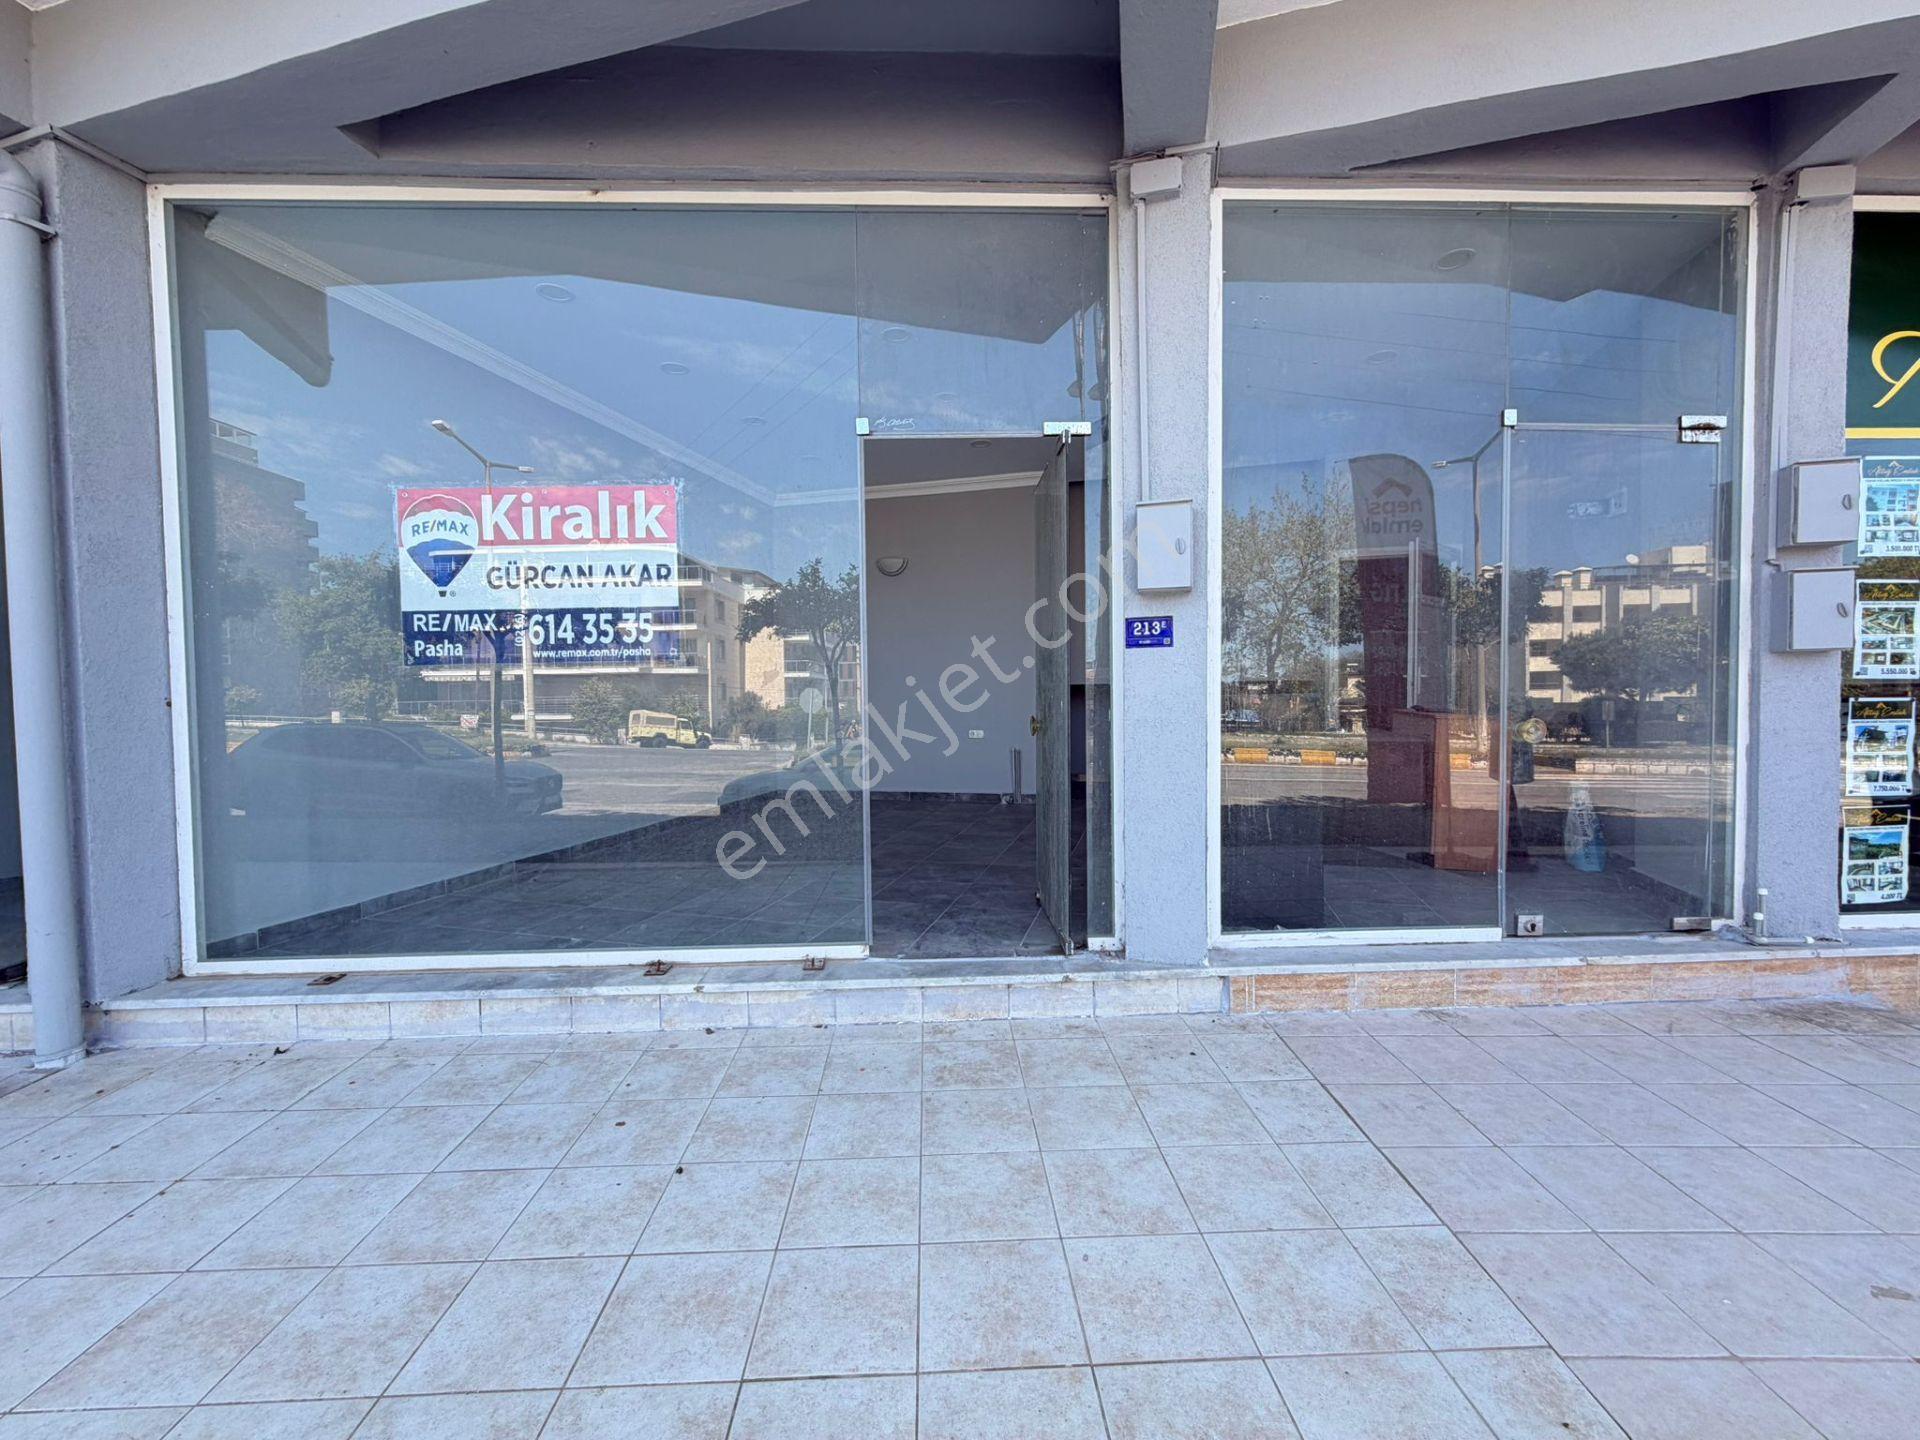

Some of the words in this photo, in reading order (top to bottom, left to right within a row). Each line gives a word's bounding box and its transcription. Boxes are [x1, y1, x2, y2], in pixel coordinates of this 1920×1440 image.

[481, 490, 668, 541] Kiralık
[411, 519, 470, 537] RE/MAX
[486, 561, 594, 590] GÜRCAN
[602, 563, 672, 588] AKAR
[413, 613, 498, 632] RE/MAX
[528, 613, 575, 645] 614
[582, 613, 615, 644] 35
[622, 612, 654, 644] 35
[414, 639, 463, 657] Pasha
[533, 646, 651, 658] www.remax.com.tr/pasha
